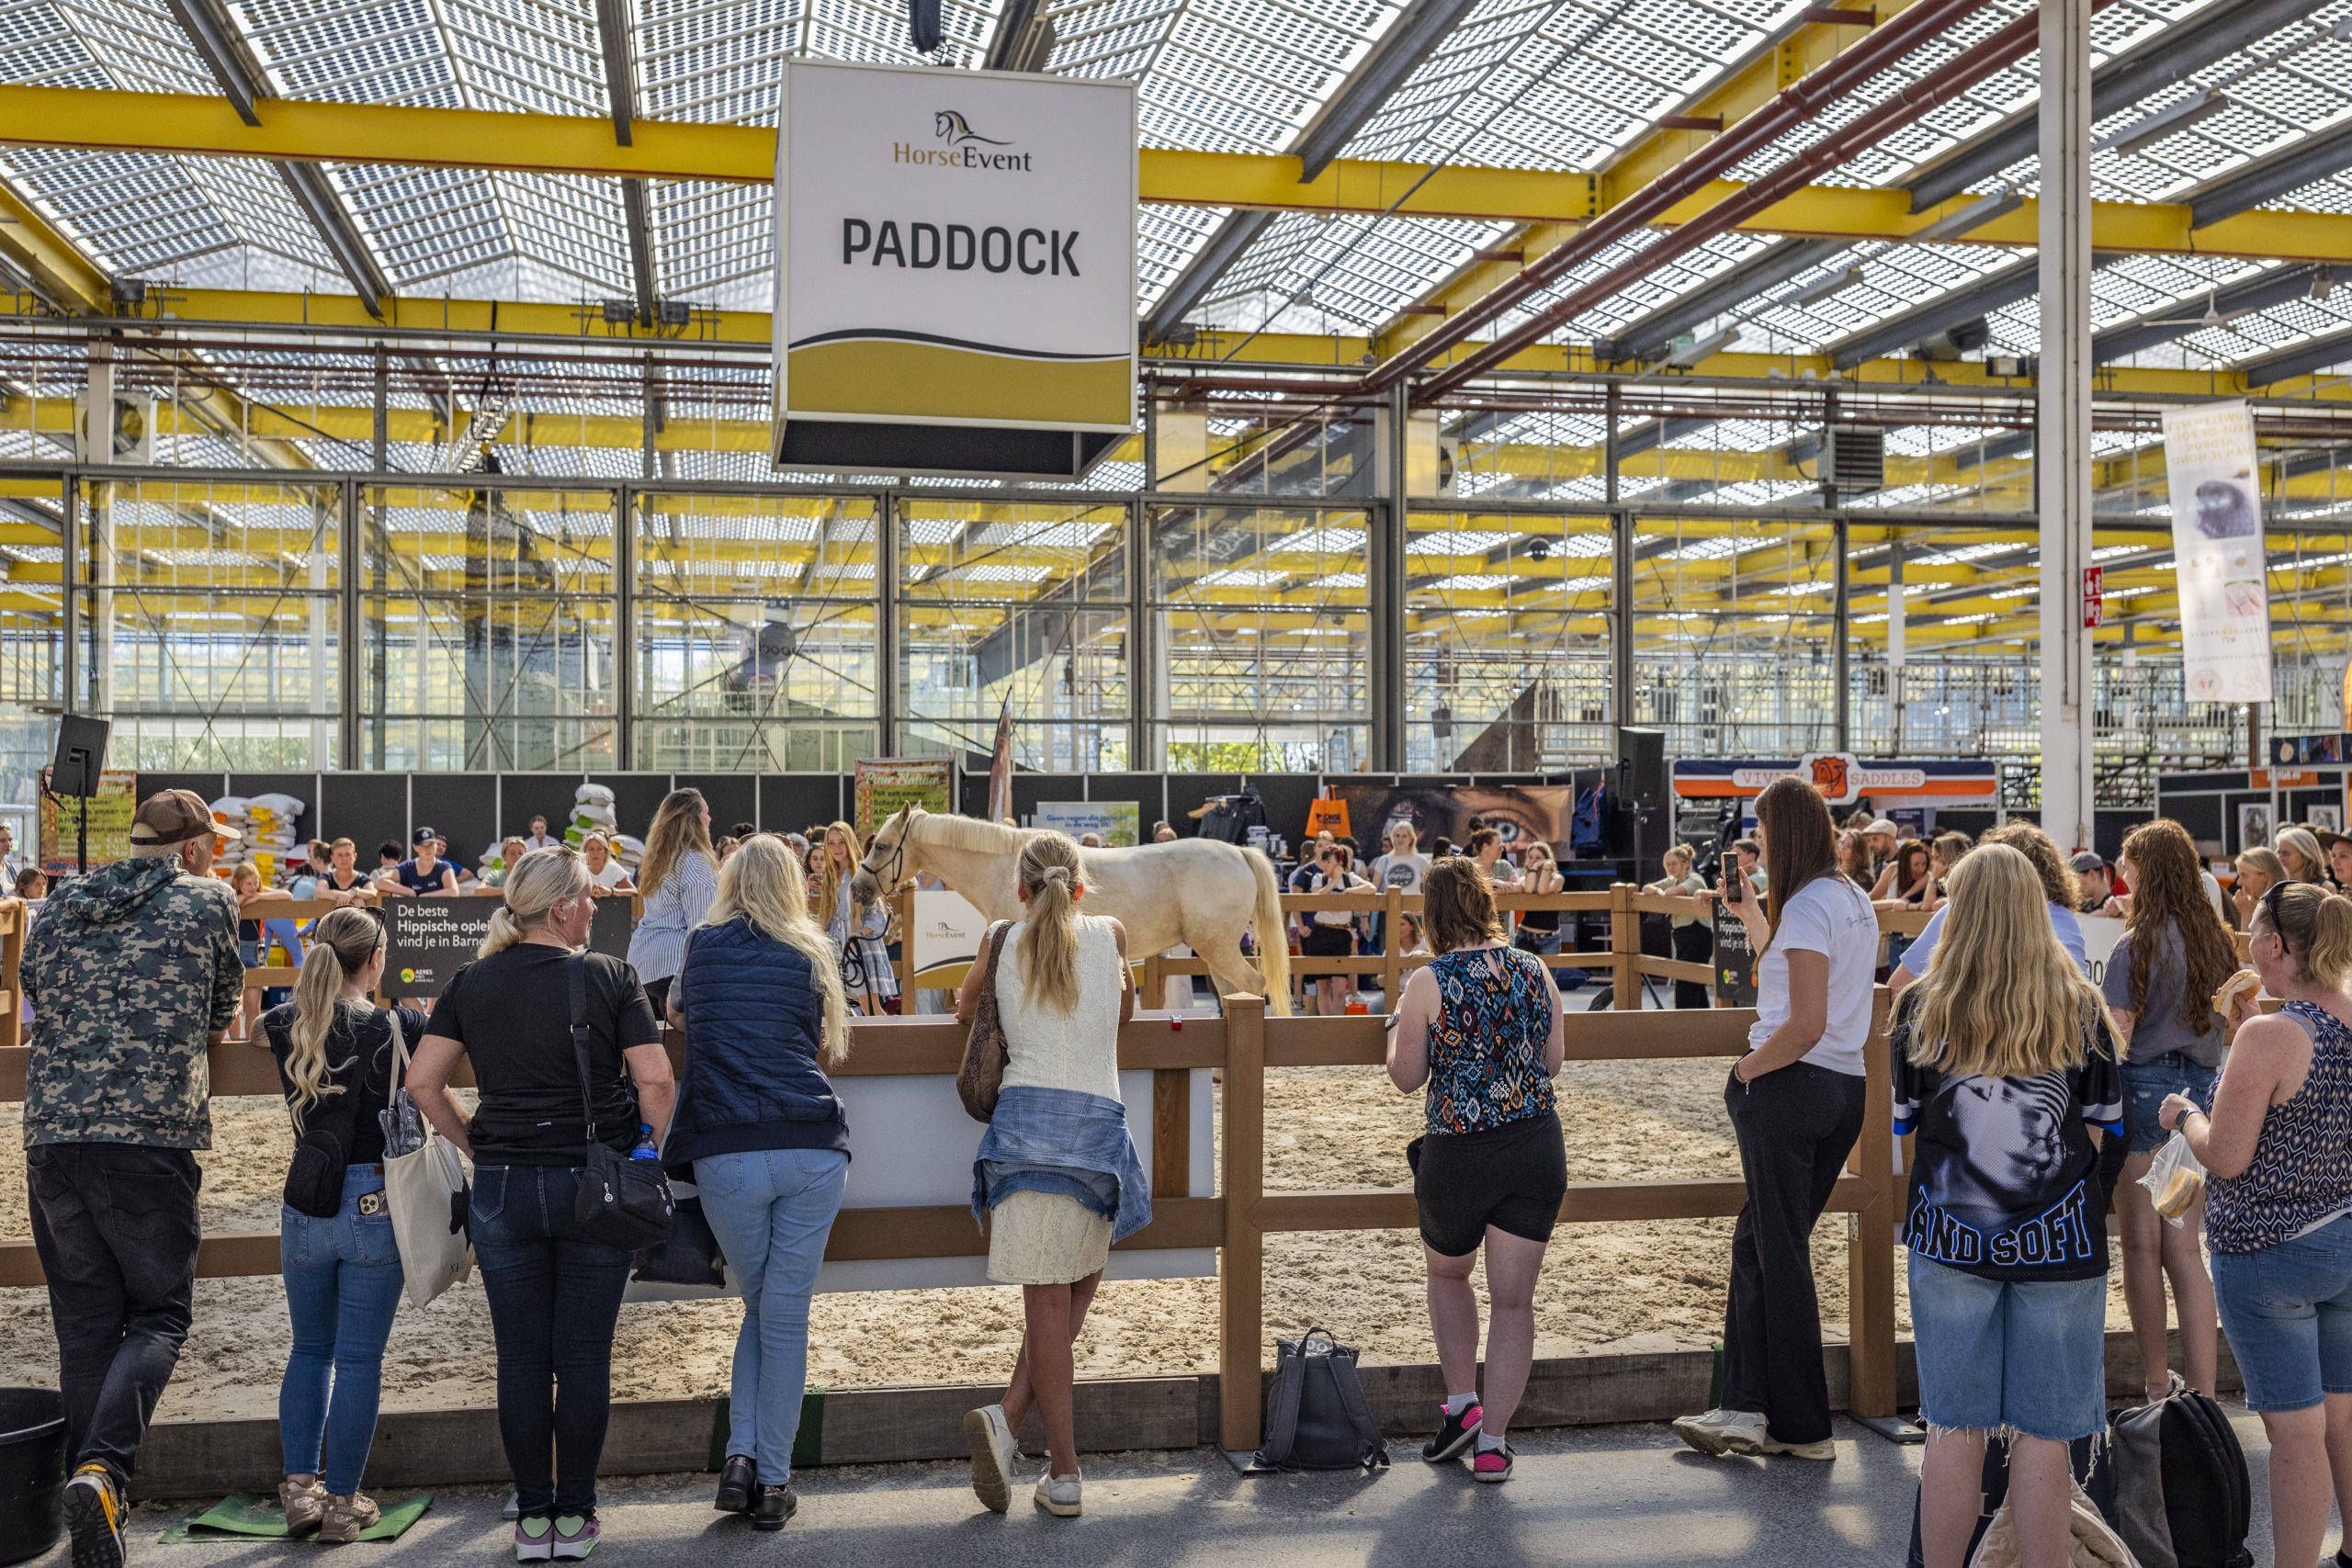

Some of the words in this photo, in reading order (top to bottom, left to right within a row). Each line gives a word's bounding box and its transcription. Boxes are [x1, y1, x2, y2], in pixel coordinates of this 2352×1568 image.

[892, 141, 1033, 172] HorseEvent
[842, 218, 1080, 276] PADDOCK
[1849, 773, 1921, 785] SADDLES
[398, 904, 415, 917] De
[417, 904, 449, 917] beste
[397, 919, 458, 935] Hippische
[460, 919, 491, 935] oplei
[397, 935, 423, 947] vind
[424, 935, 436, 951] je
[438, 935, 449, 947] in
[452, 935, 485, 947] Barne
[1906, 1185, 1982, 1264] AND
[1992, 1179, 2092, 1266] SOFT
